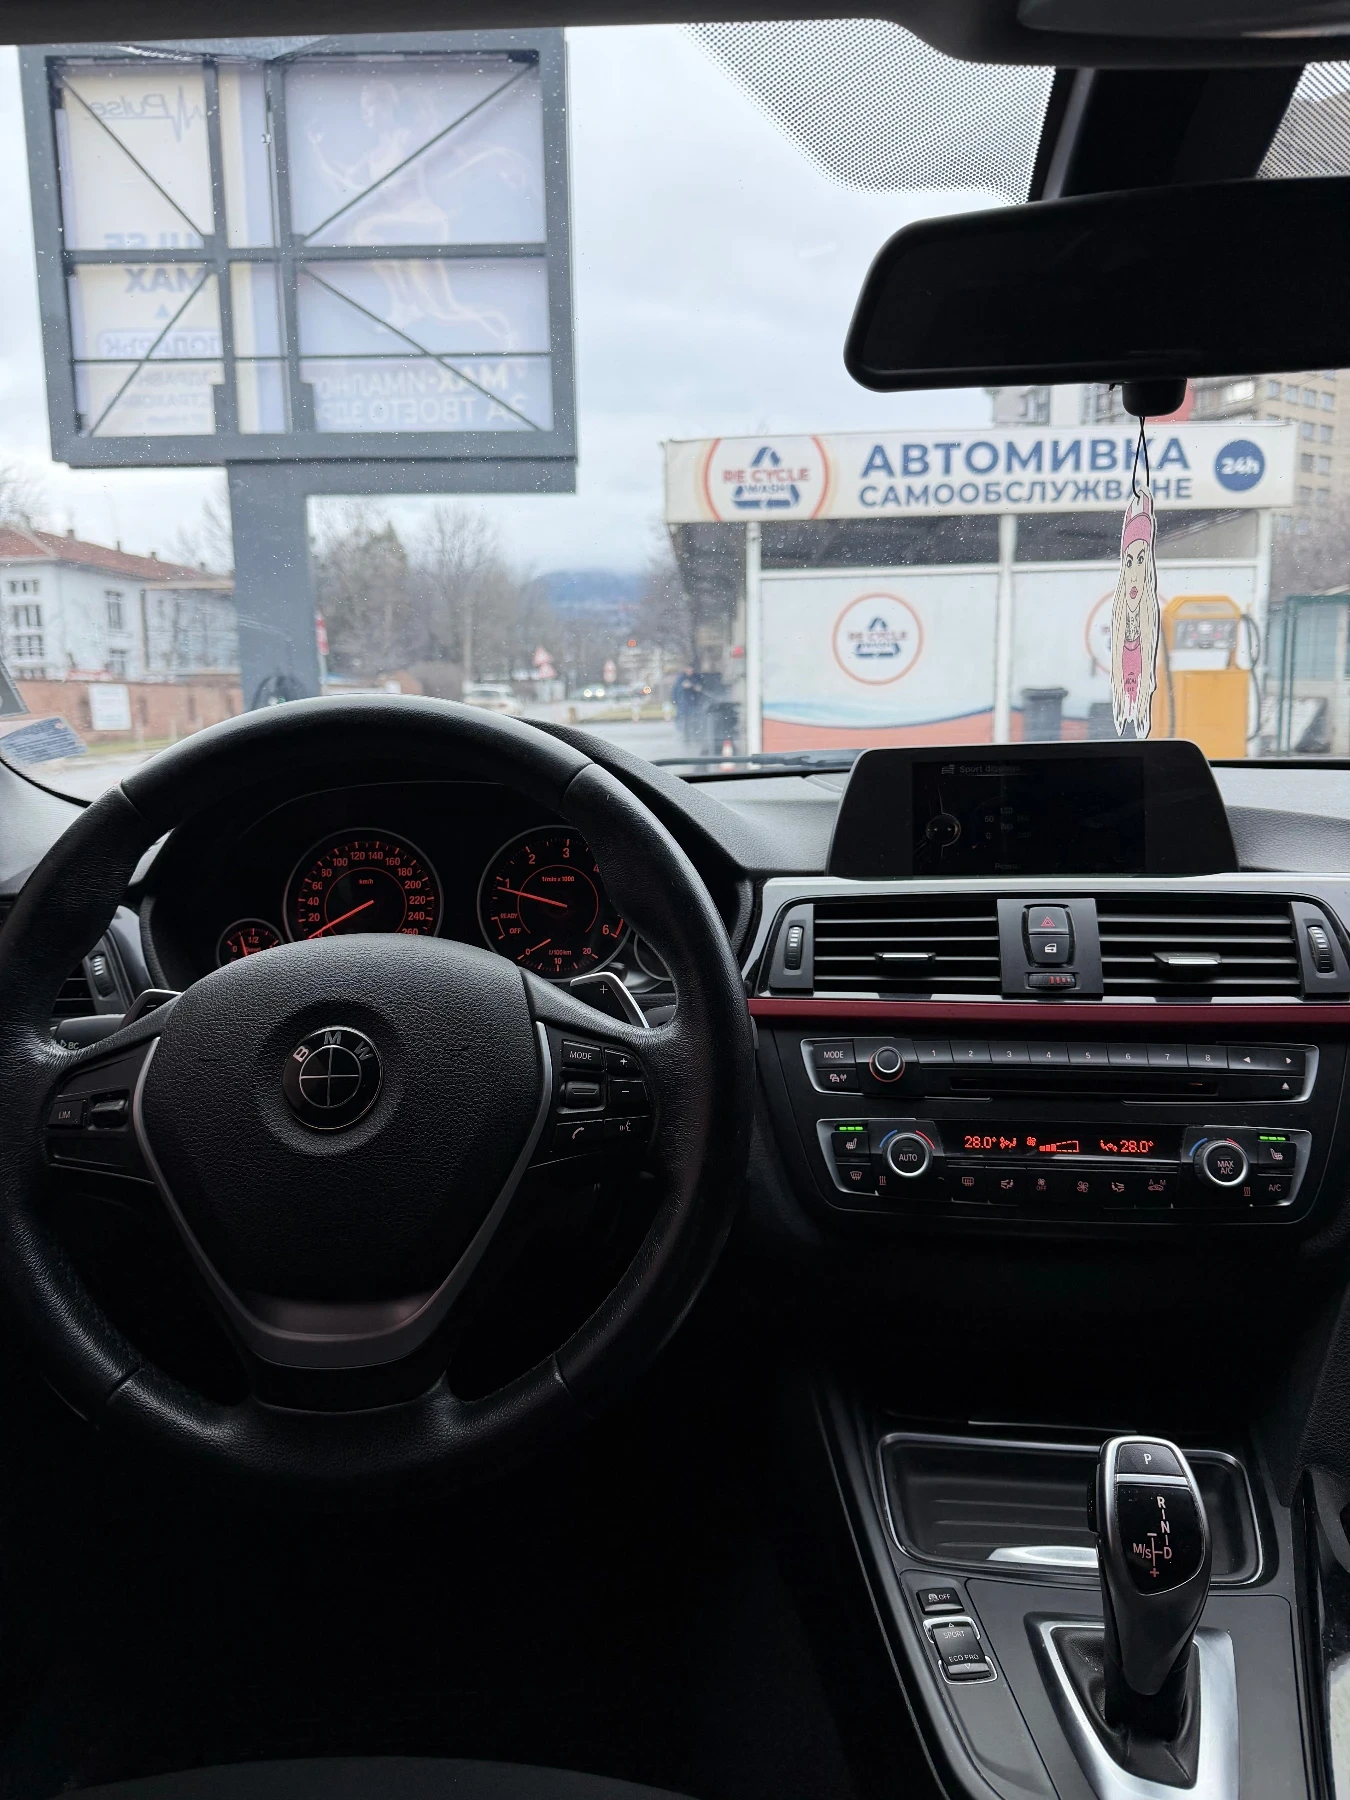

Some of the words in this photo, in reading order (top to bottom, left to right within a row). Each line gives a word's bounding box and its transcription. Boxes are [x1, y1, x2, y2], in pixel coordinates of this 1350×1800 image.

[861, 437, 1191, 478] АВТОМИВКА
[1221, 457, 1260, 475] 24h
[751, 467, 810, 482] CYCLE
[959, 765, 983, 774] Sport
[350, 852, 365, 860] 120
[368, 852, 383, 860] 140
[563, 848, 570, 858] 3
[333, 858, 348, 866] 100
[385, 857, 400, 866] 160
[528, 854, 536, 864] 2
[321, 868, 332, 877] 80
[397, 868, 413, 876] 180
[593, 864, 600, 873] 4
[312, 882, 322, 890] 60
[405, 880, 421, 889] 200
[505, 878, 510, 888] 1
[307, 897, 319, 905] 40
[409, 896, 426, 904] 220
[308, 913, 320, 922] 20
[408, 912, 425, 920] 240
[602, 925, 610, 935] 6
[68, 1042, 80, 1050] BC
[292, 1031, 374, 1063] BMW
[569, 1050, 592, 1060] MODE
[823, 1050, 844, 1059] MODE
[58, 1111, 71, 1119] LIM
[964, 1136, 997, 1149] 28.0°
[1120, 1139, 1154, 1153] 28.0°
[898, 1153, 918, 1162] AUTO
[1217, 1160, 1234, 1168] MAX
[1220, 1167, 1233, 1175] A/C
[1268, 1184, 1282, 1192] A/C
[1144, 1453, 1152, 1465] P
[1156, 1496, 1166, 1509] R
[1160, 1520, 1171, 1534] N
[1132, 1543, 1152, 1559] M/S
[1163, 1547, 1172, 1559] D
[943, 1630, 965, 1639] SPORT
